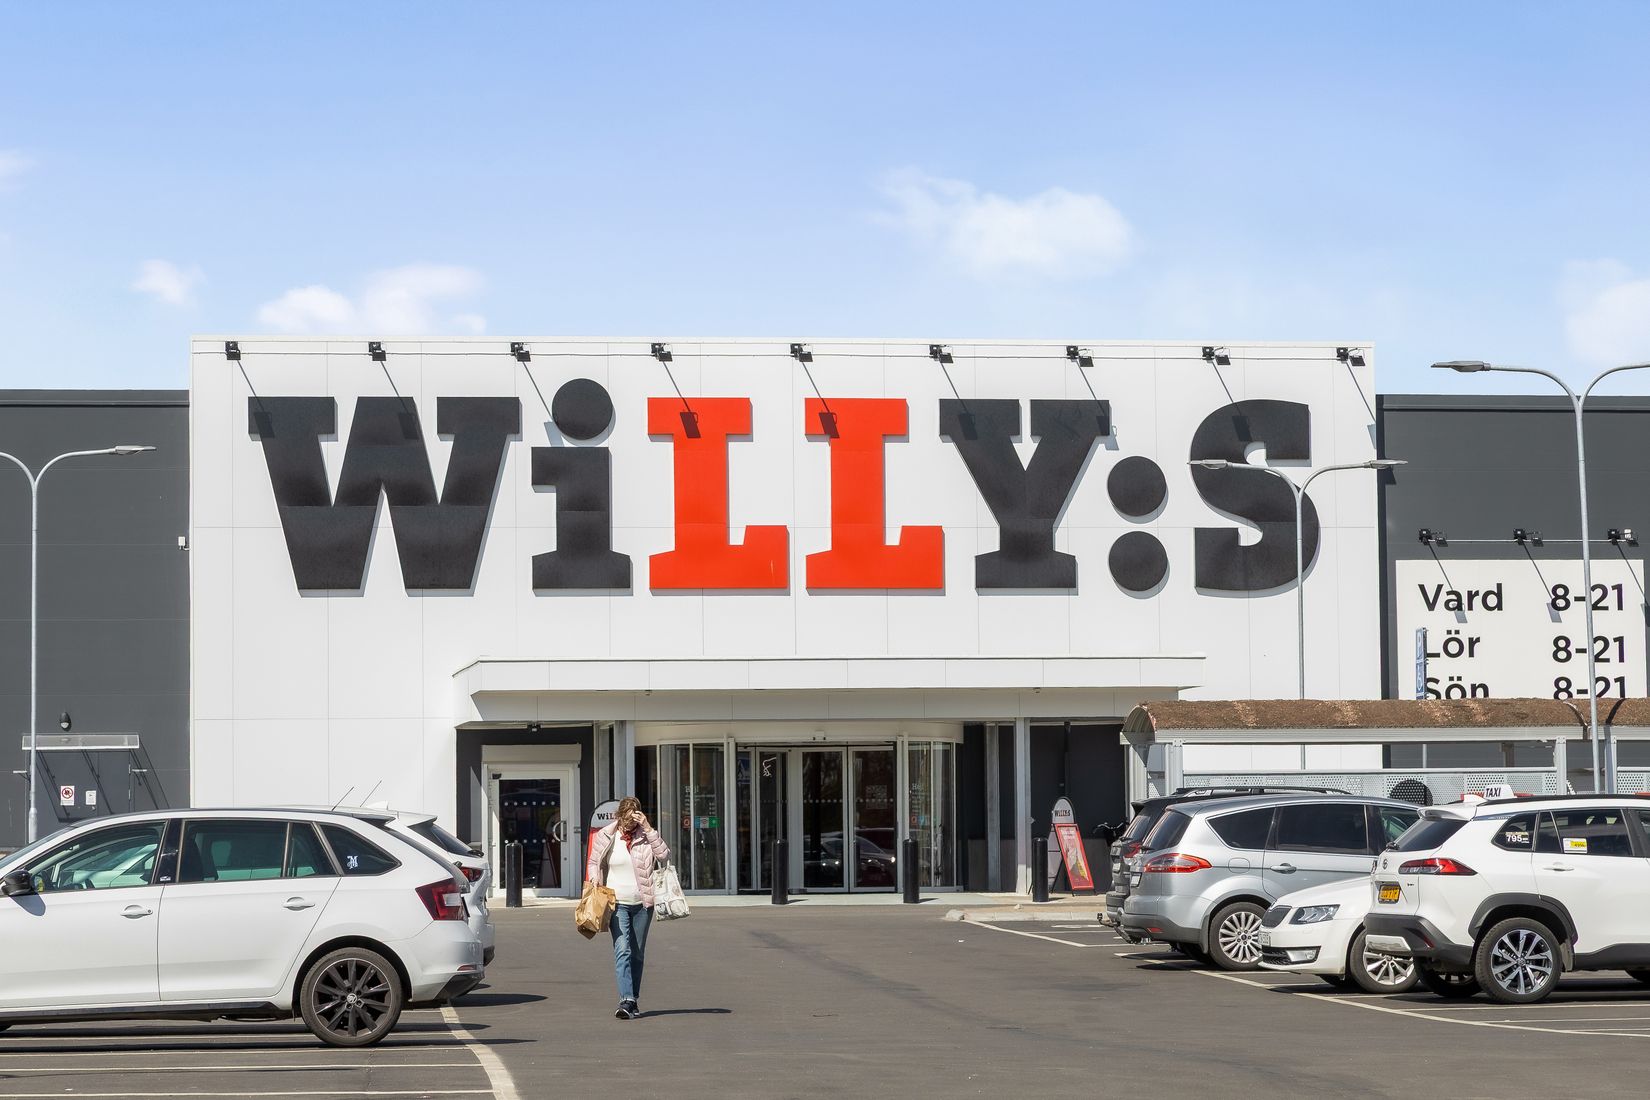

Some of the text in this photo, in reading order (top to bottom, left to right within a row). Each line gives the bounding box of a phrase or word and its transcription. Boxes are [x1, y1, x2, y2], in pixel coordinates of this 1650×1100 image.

[1418, 583, 1623, 611] Vard 8-21
[1552, 635, 1625, 663] 8-21
[1426, 675, 1626, 700] Sön 8-21
[1485, 787, 1501, 797] TAXI
